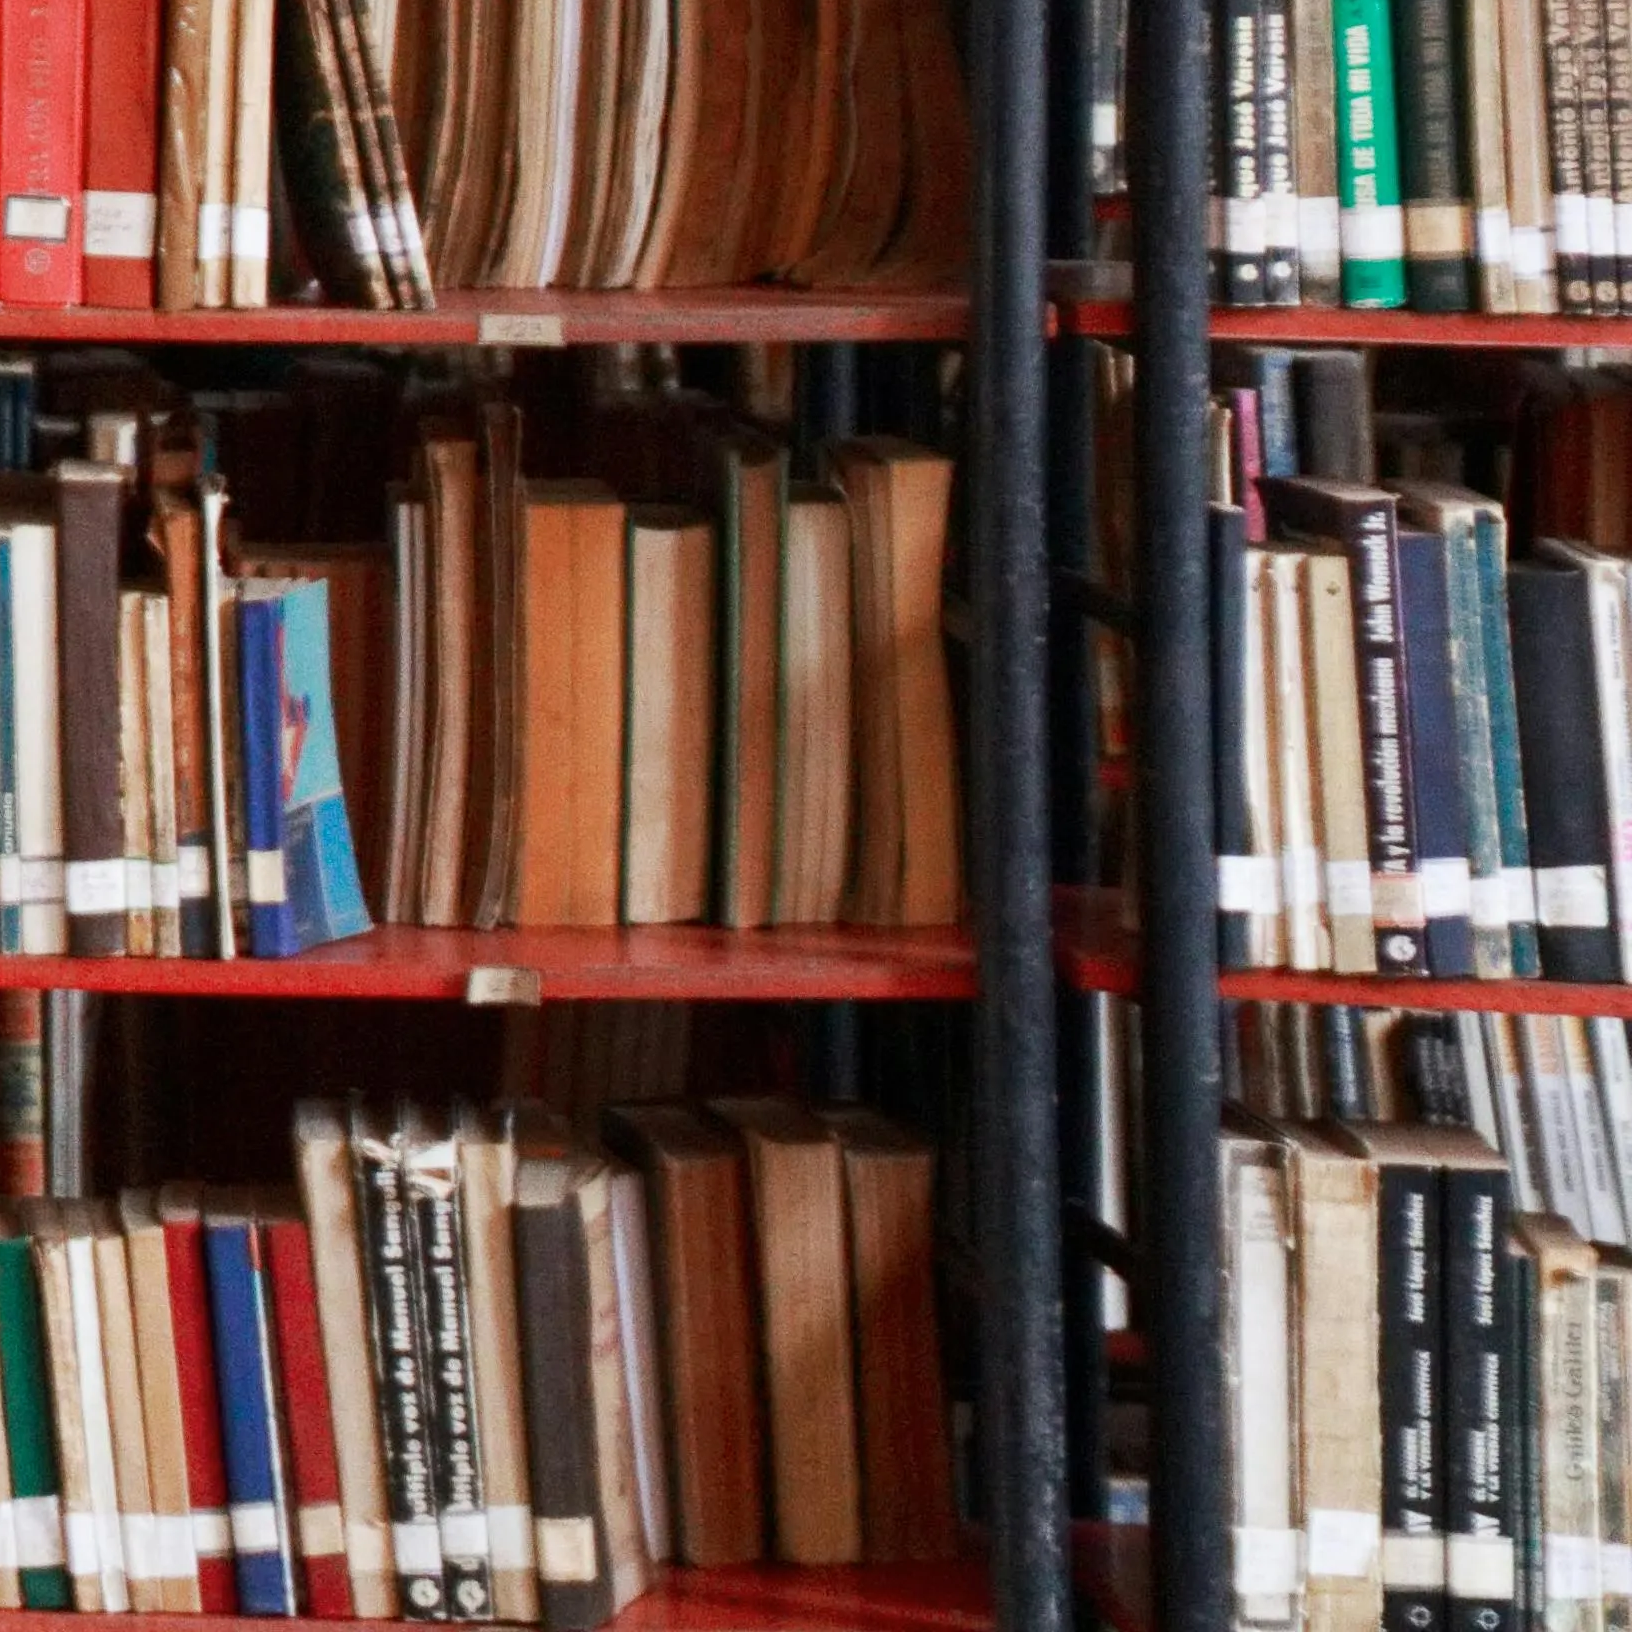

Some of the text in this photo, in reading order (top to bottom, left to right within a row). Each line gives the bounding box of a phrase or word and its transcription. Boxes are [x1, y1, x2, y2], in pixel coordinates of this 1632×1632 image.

[1344, 24, 1371, 66] VIDA
[1230, 16, 1256, 150] José Varona
[1264, 13, 1288, 147] José Varona
[1347, 67, 1372, 93] MI
[1350, 95, 1375, 143] TODA
[1351, 146, 1377, 170] DE
[1361, 510, 1394, 643] John Womack Jr.
[1370, 657, 1412, 857] y la revolución mexicana
[2, 791, 14, 854] anuela
[384, 1265, 412, 1351] Manuel
[433, 1266, 460, 1351] Manuel
[1406, 1292, 1425, 1323] José
[1475, 1295, 1494, 1325] José
[395, 1356, 416, 1387] de
[442, 1357, 463, 1388] de
[402, 1391, 420, 1435] voz
[449, 1391, 467, 1436] voz
[1418, 1419, 1432, 1469] VERDAD
[1486, 1422, 1500, 1473] VERDAD
[1418, 1471, 1432, 1488] LA
[1486, 1474, 1500, 1491] LA
